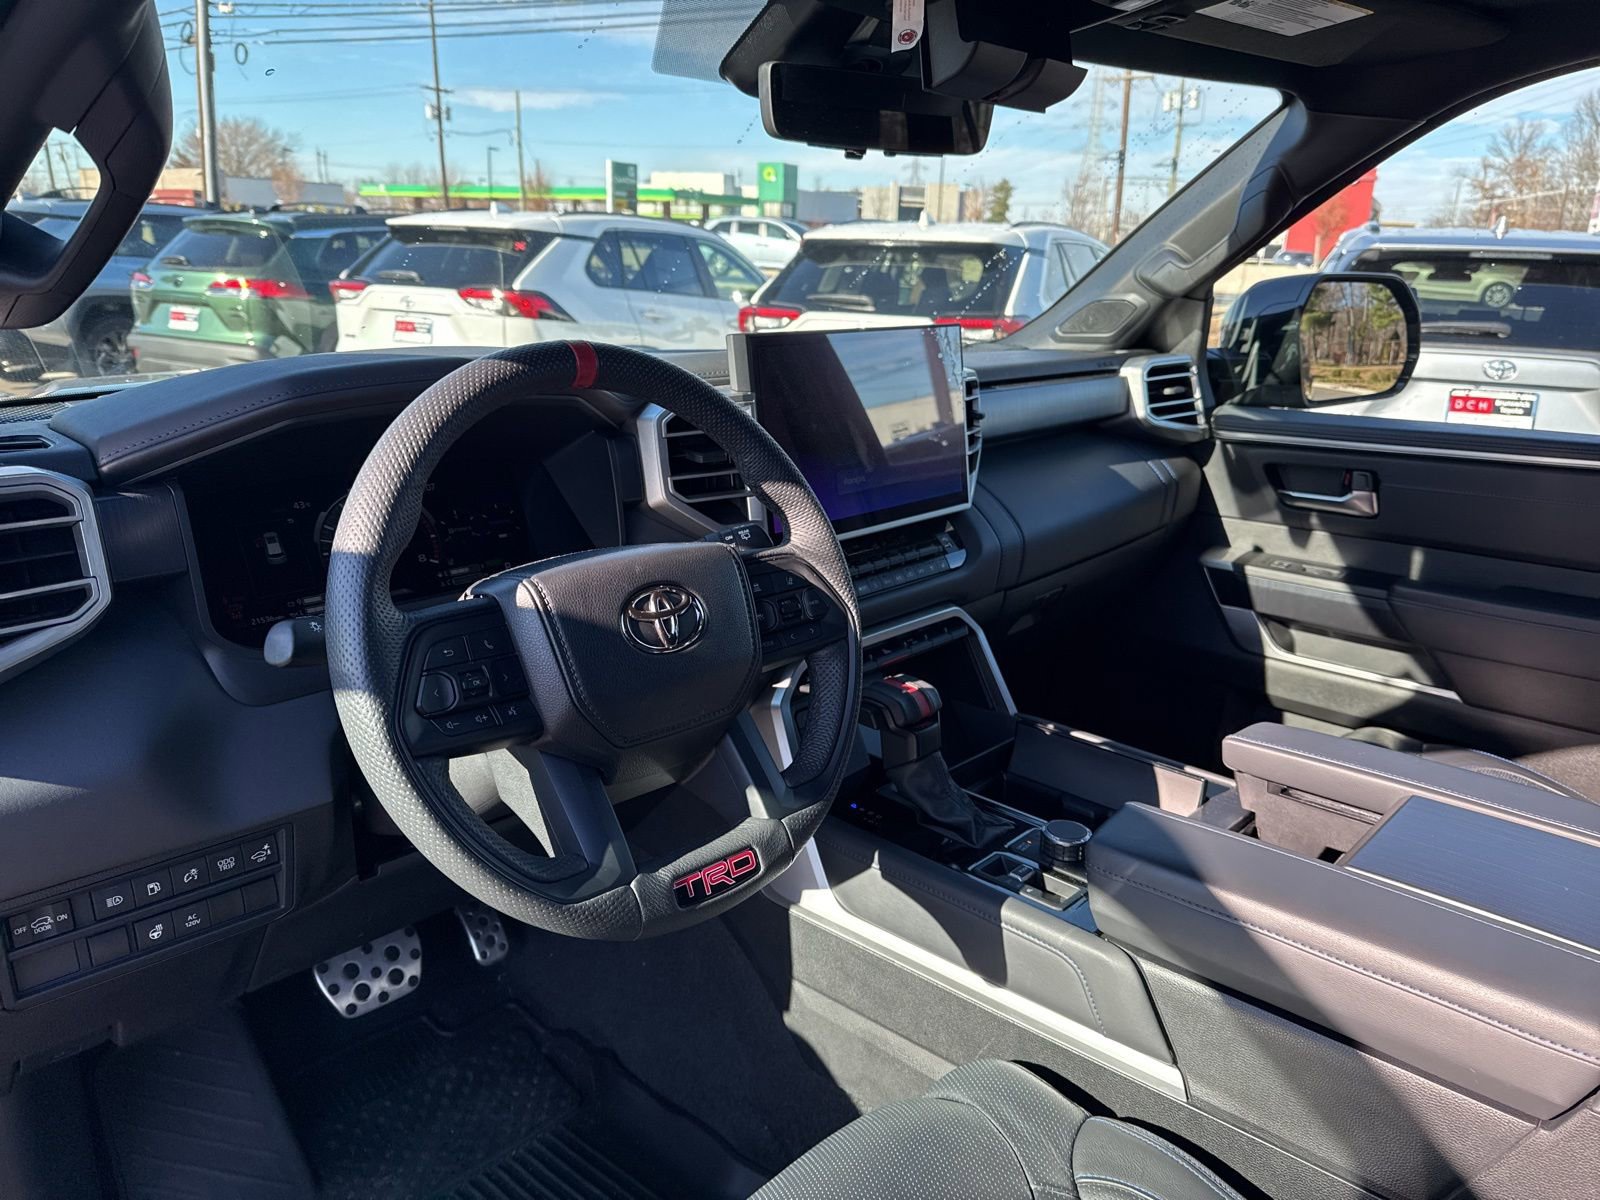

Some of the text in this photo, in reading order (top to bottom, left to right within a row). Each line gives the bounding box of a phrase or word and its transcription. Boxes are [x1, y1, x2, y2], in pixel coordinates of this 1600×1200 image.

[1454, 399, 1488, 411] DCH
[217, 856, 235, 867] ODO
[218, 862, 236, 872] TRIP
[673, 848, 758, 898] TRD
[187, 913, 198, 921] AC
[14, 913, 68, 935] OFF ON
[185, 918, 201, 928] 120V
[33, 924, 52, 934] DOOR
